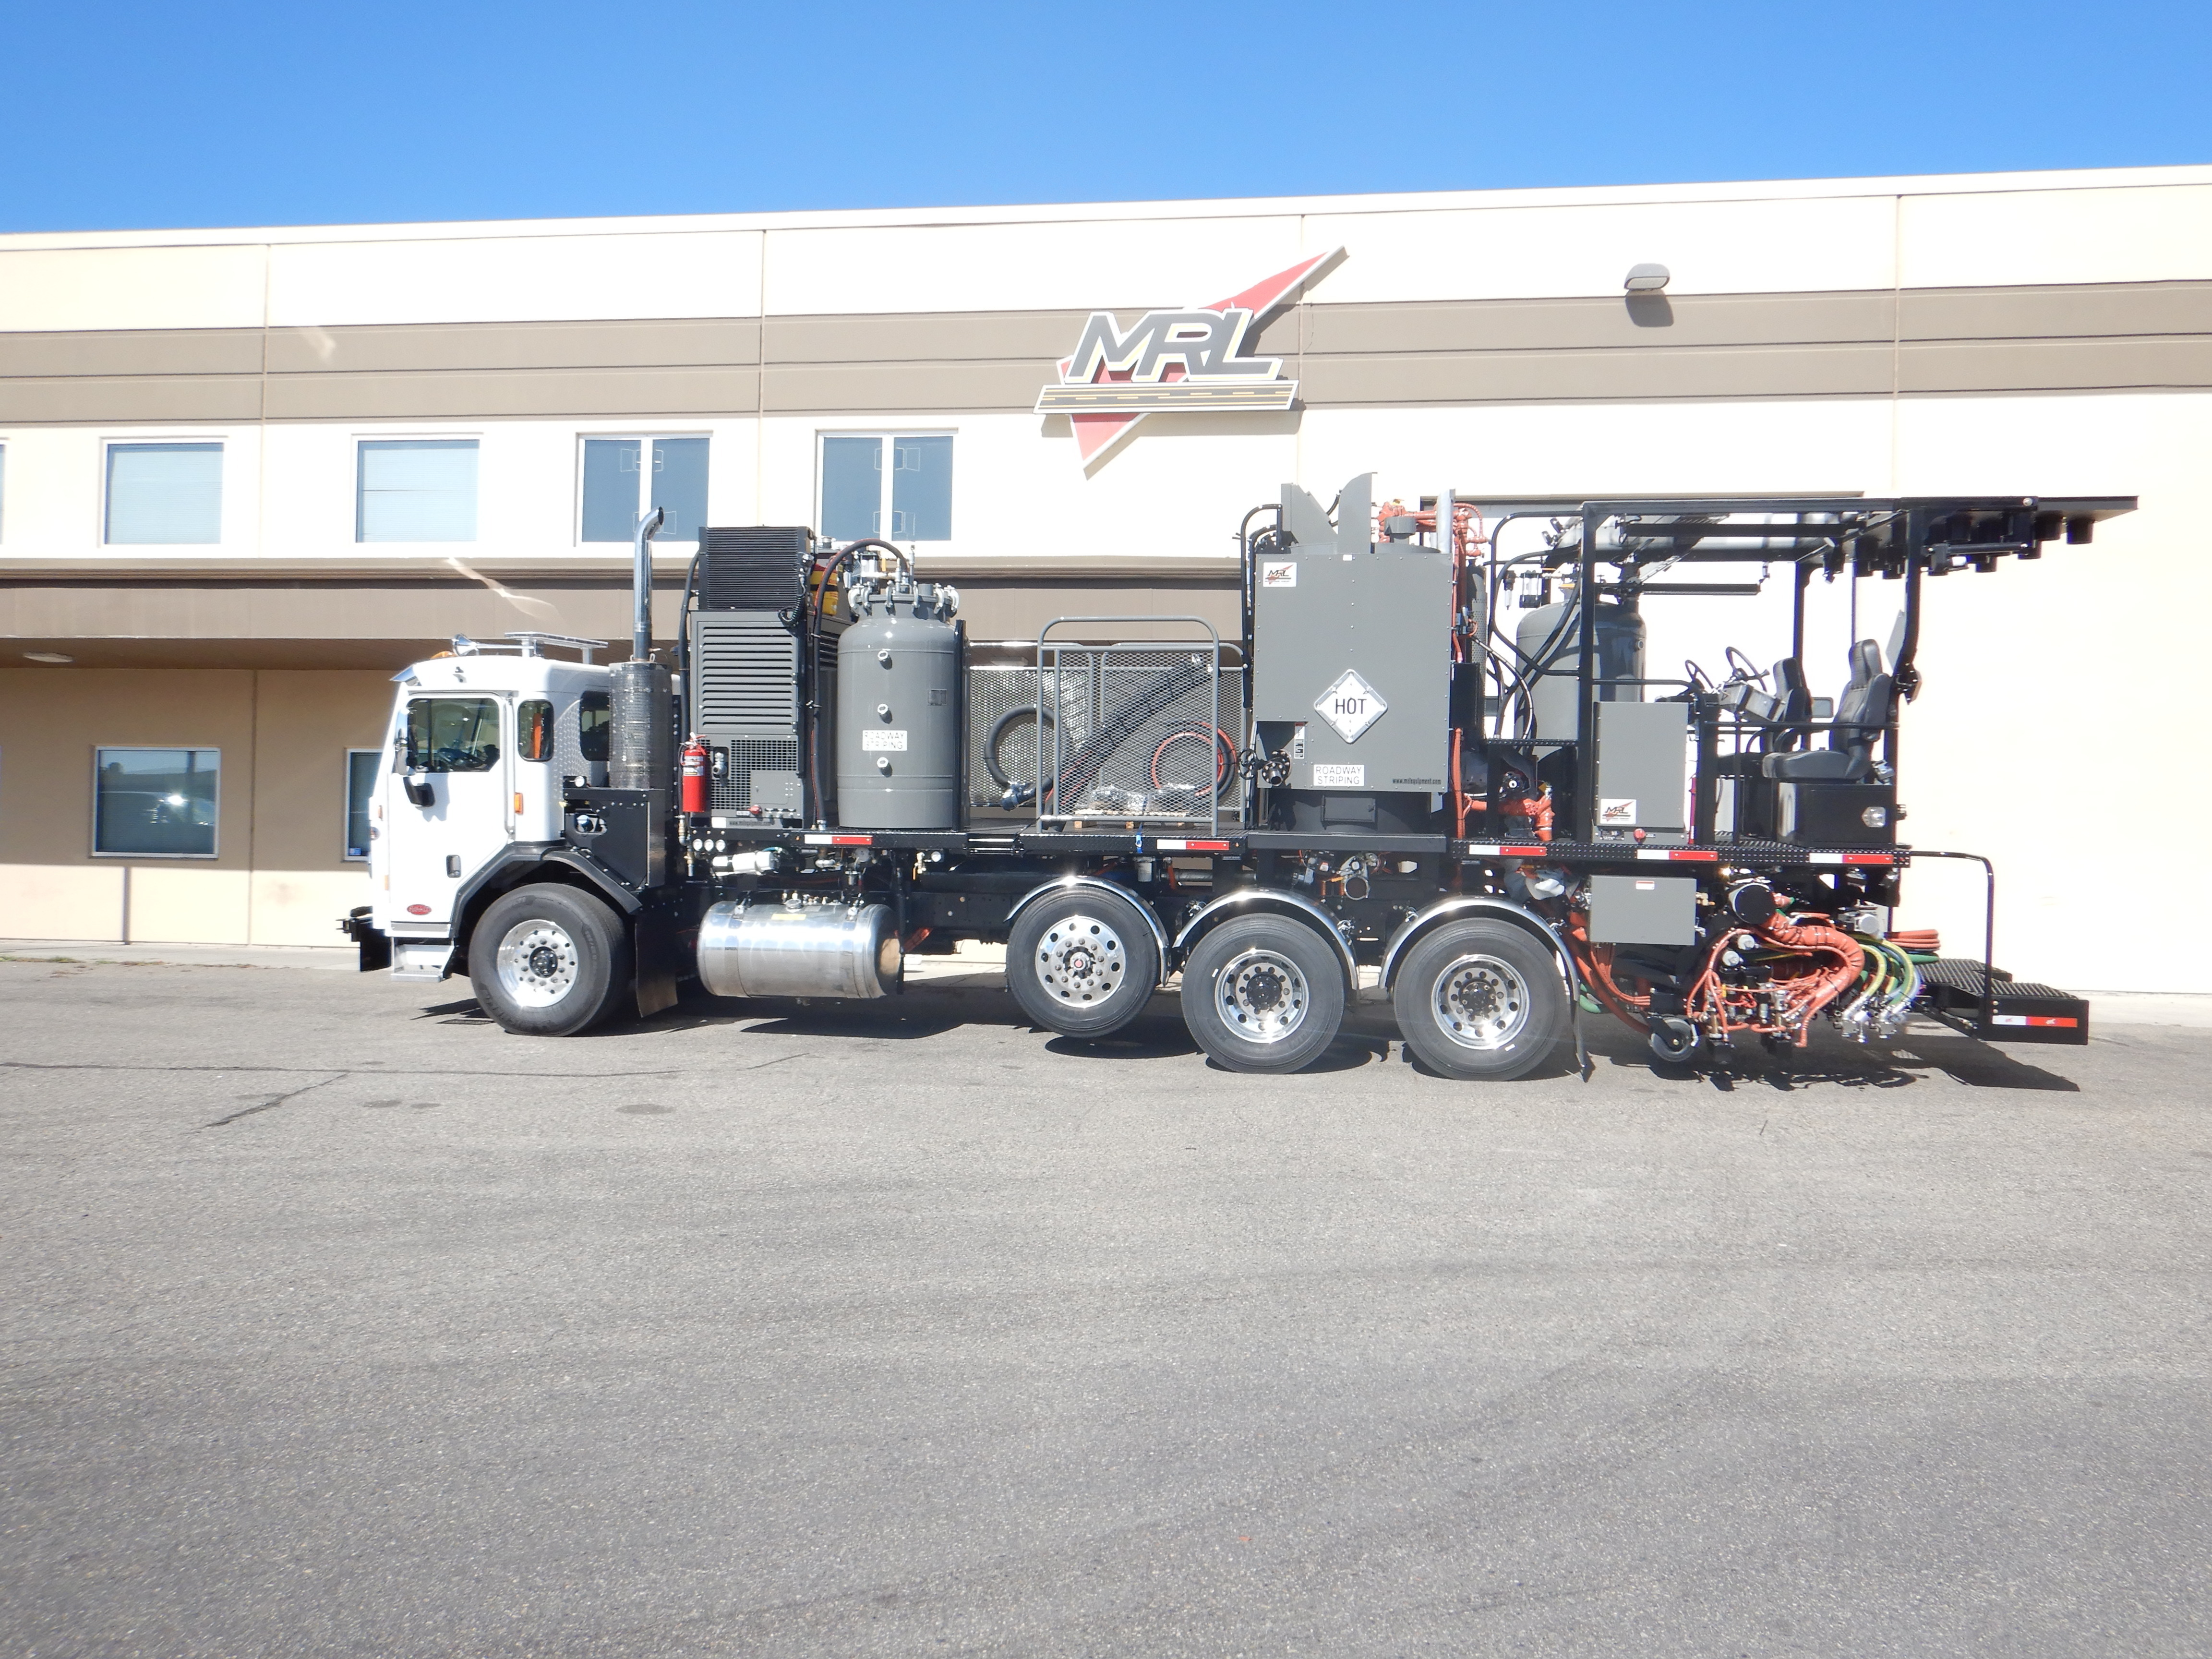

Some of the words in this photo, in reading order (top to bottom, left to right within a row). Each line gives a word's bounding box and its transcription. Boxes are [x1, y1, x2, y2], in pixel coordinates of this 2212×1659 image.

[1065, 308, 1283, 383] MRL
[1335, 697, 1367, 714] HOT
[1316, 766, 1361, 774] ROADWAY
[1318, 776, 1359, 784] STRIPING
